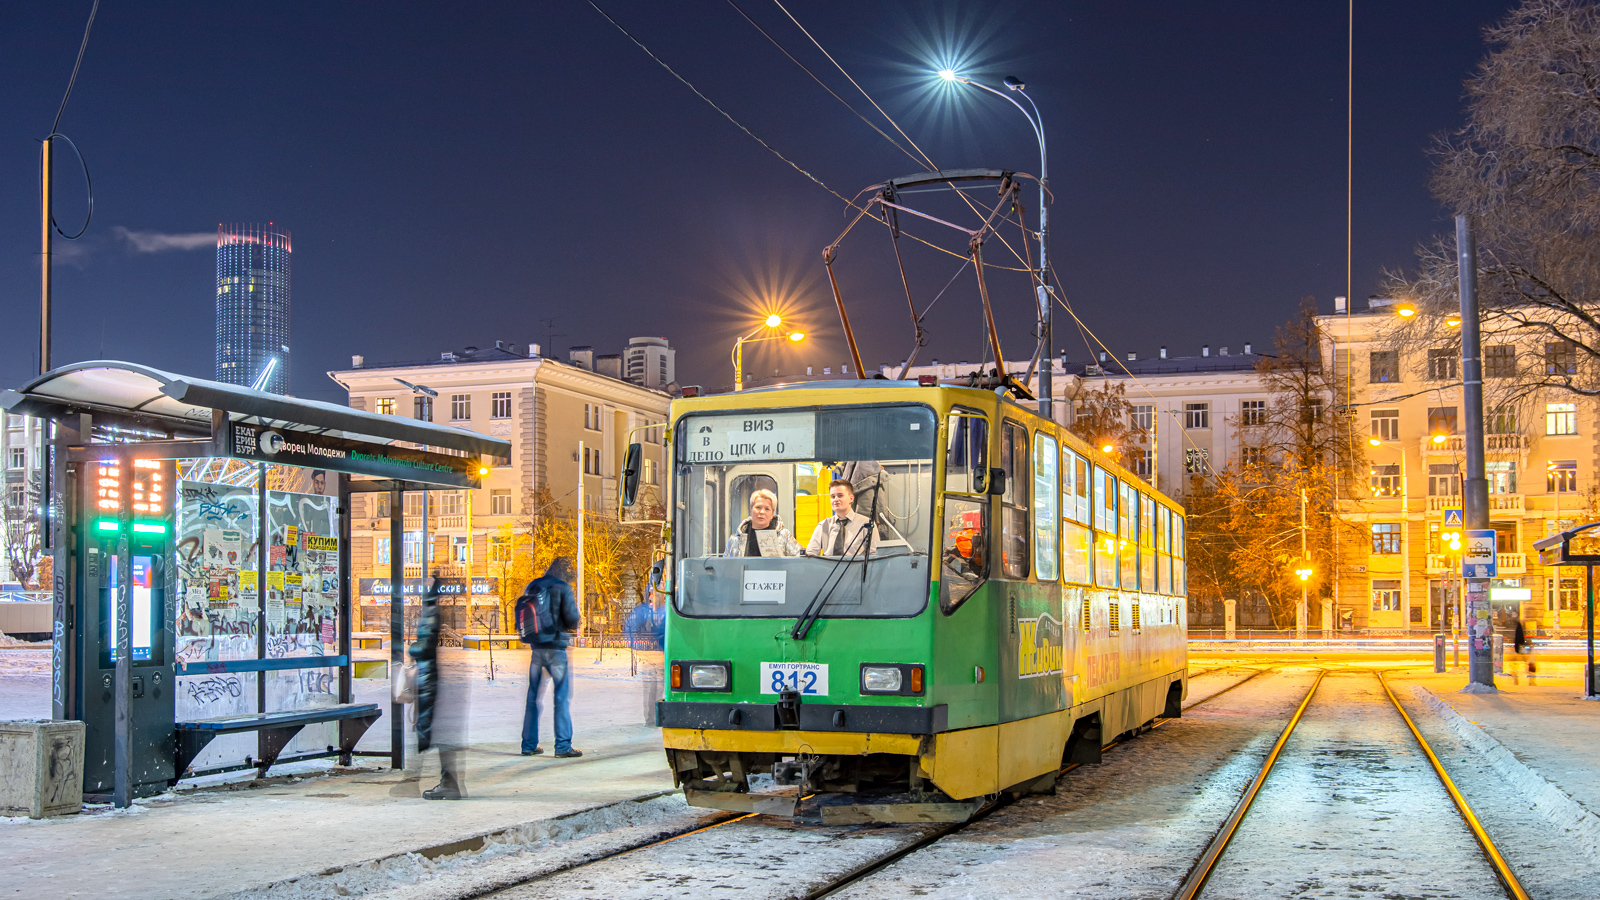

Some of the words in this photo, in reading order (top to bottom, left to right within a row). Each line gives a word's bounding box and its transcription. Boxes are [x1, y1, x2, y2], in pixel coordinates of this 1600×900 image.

[235, 426, 256, 437] ЕКАТ
[743, 420, 774, 432] ВИЗ
[235, 435, 256, 447] ЕРИН
[702, 437, 711, 446] В
[236, 445, 256, 455] БУРГ
[308, 443, 346, 459] Молодежи
[730, 443, 757, 457] ЦПК
[763, 444, 771, 454] и
[351, 450, 376, 463] Dvorets
[377, 454, 412, 468] Molodyozhi
[413, 461, 434, 471] Culture
[435, 463, 453, 474] Centre
[688, 451, 724, 462] ДЕПО
[308, 537, 337, 546] КУПИМ
[771, 671, 817, 694] 812
